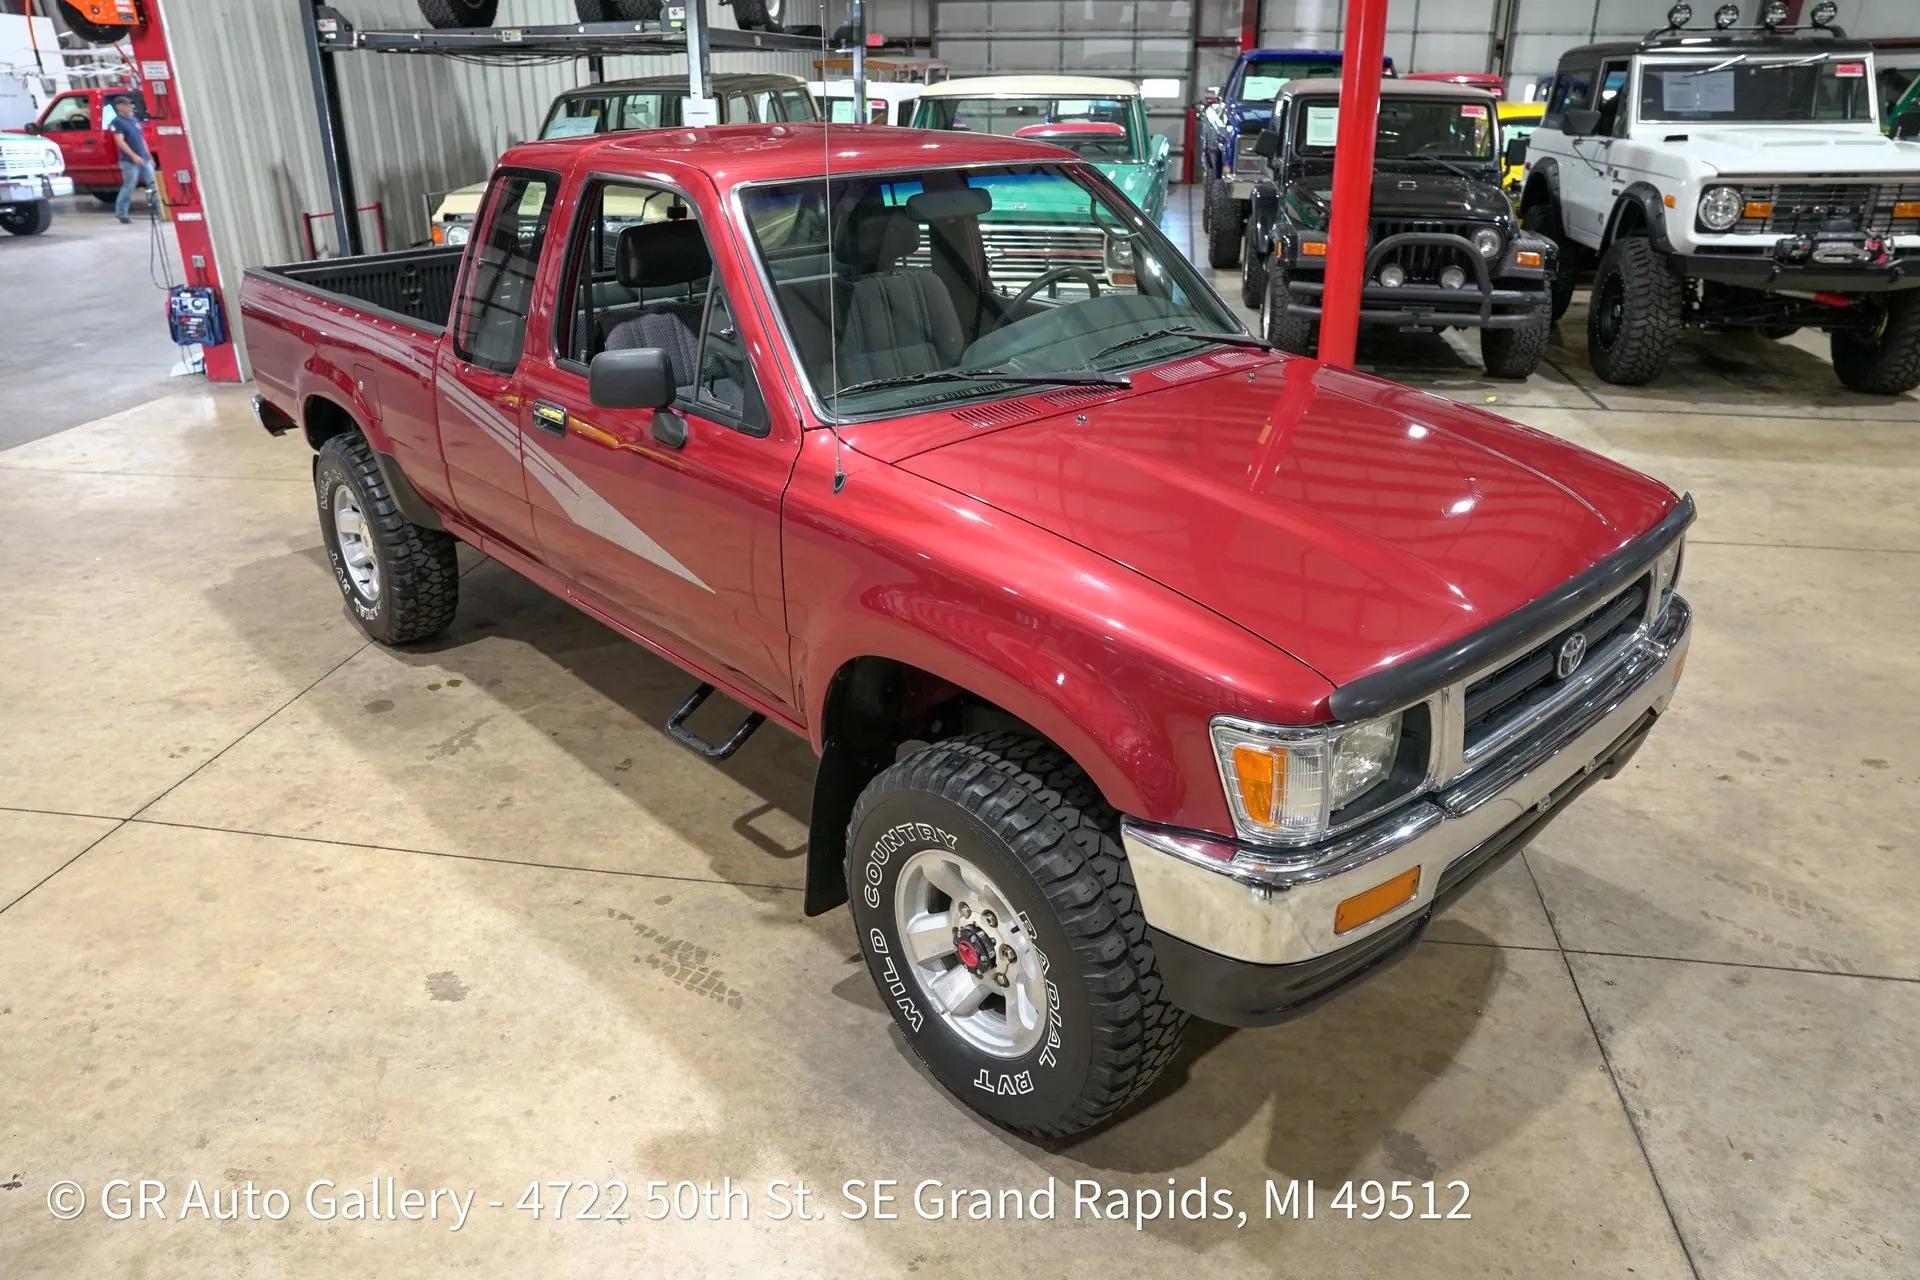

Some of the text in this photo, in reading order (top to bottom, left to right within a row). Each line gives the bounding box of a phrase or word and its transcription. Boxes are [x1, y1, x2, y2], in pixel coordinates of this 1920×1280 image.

[864, 822, 958, 1033] WILD COUNTRY
[973, 1068, 1034, 1095] RVT
